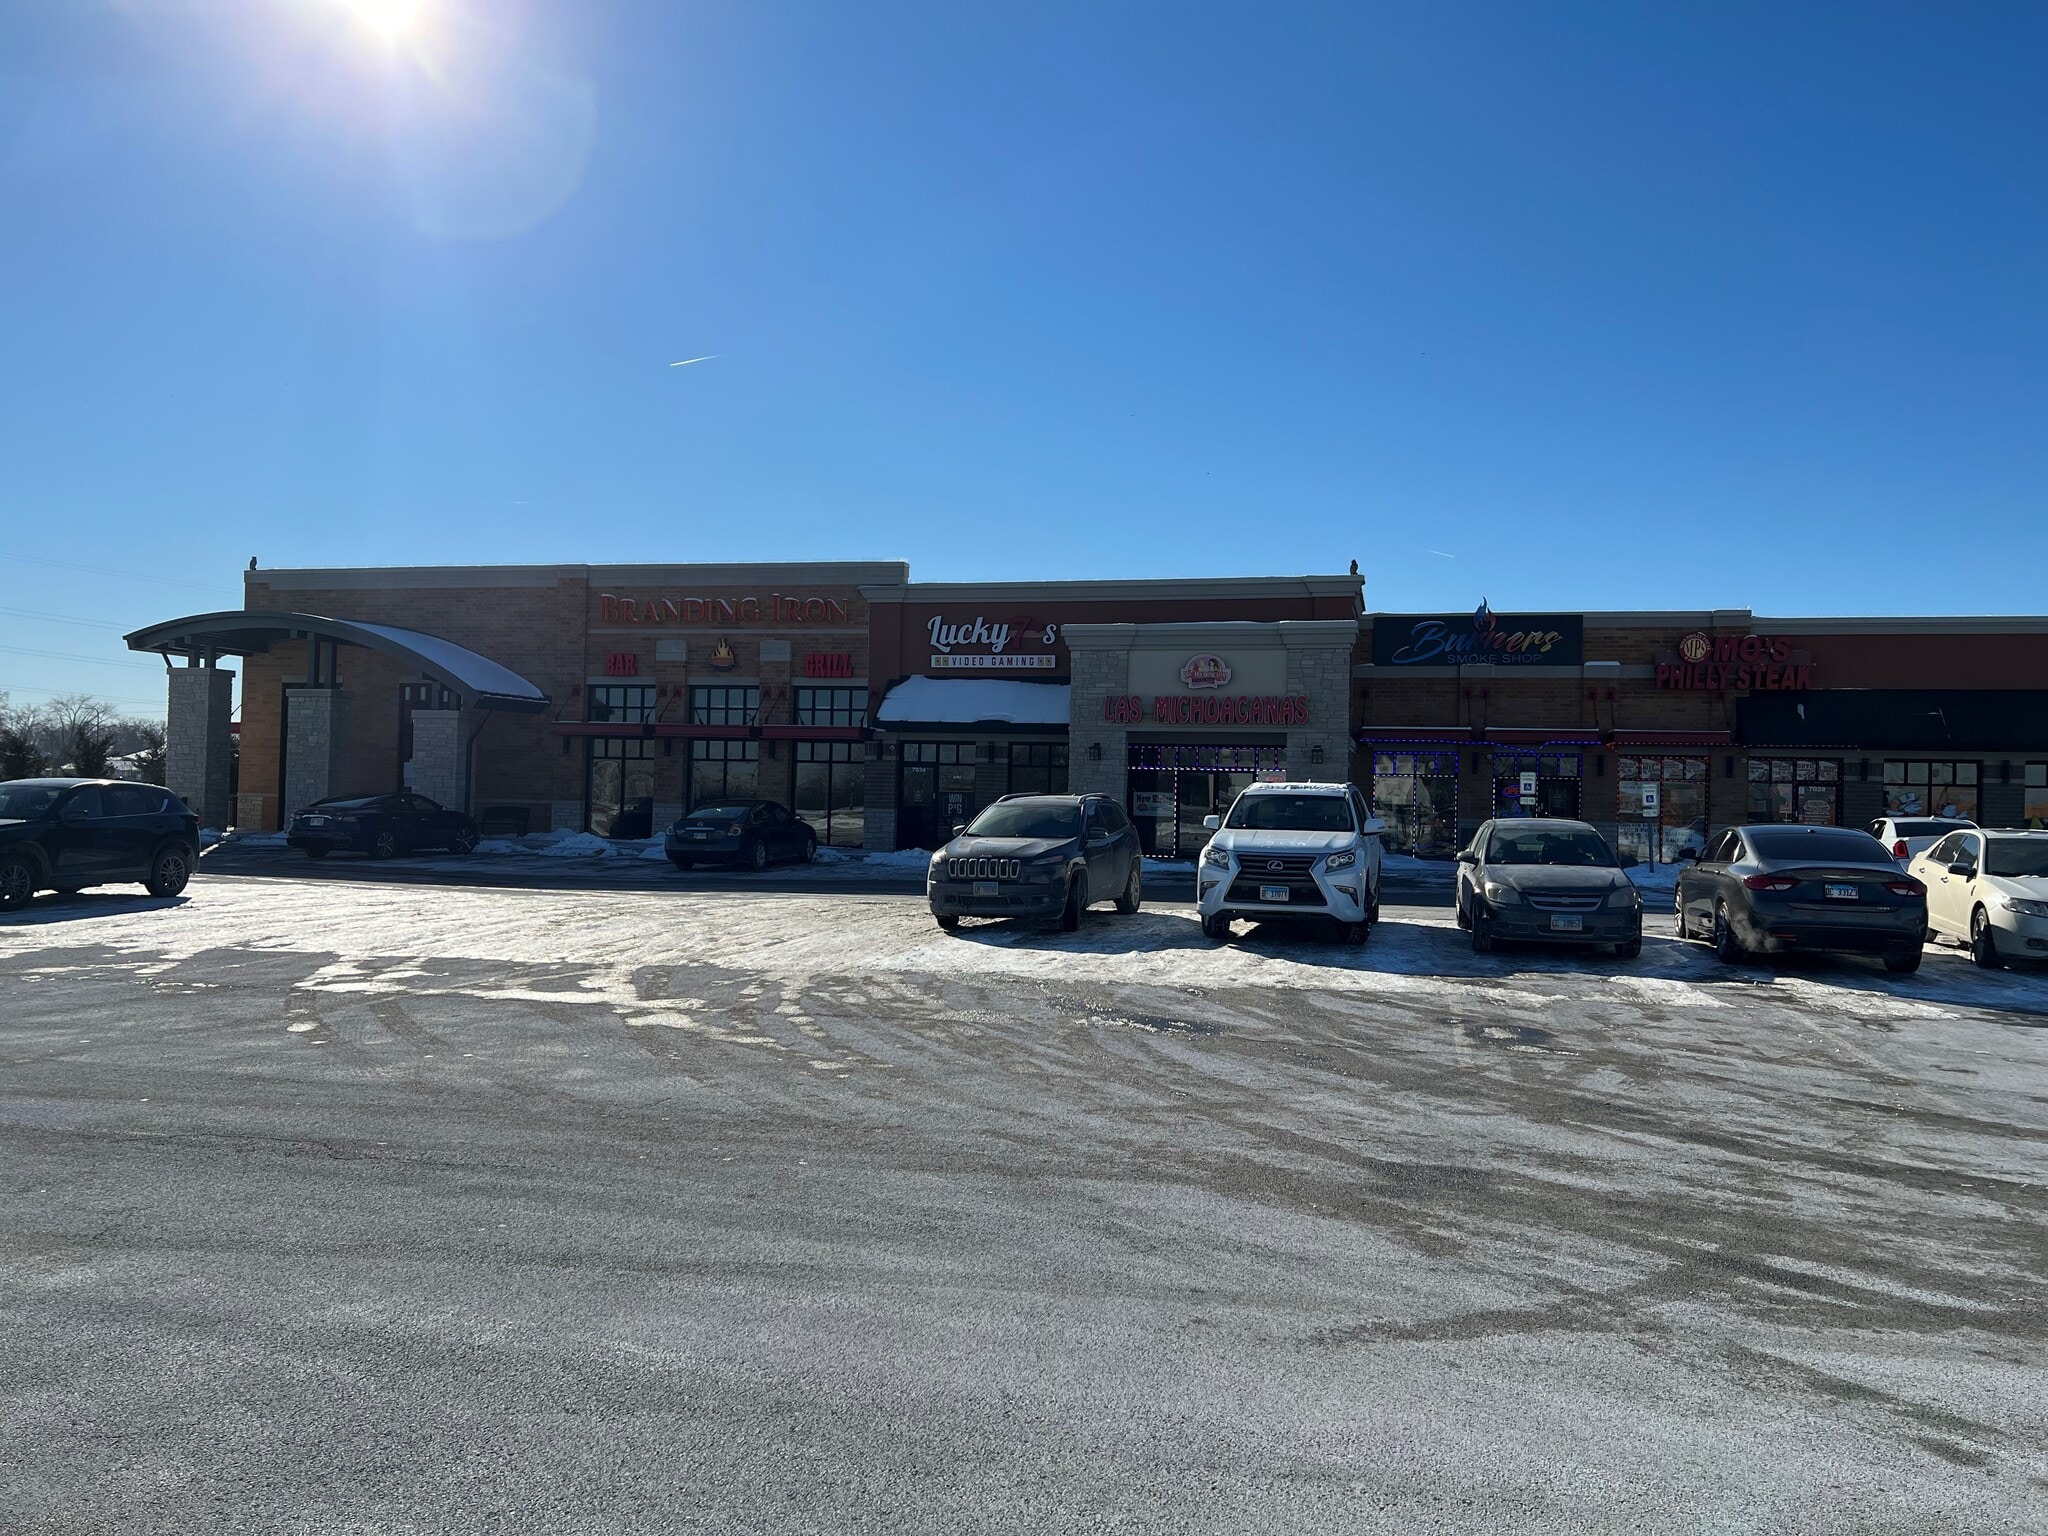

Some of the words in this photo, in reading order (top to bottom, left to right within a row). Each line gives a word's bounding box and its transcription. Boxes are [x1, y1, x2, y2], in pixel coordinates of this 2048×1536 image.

[599, 593, 759, 624] BRANDING
[771, 593, 848, 624] IRON
[927, 615, 1011, 653] Lucky
[604, 653, 637, 677] BAR
[804, 654, 854, 678] GRILL
[952, 657, 984, 666] VIDEO
[991, 657, 1035, 666] GAMING
[1446, 654, 1497, 665] SMOKE
[1502, 654, 1542, 664] SHOP
[1655, 663, 1731, 690] PHILLY
[1735, 663, 1814, 690] STEAK
[1103, 696, 1143, 723] LAS
[1153, 696, 1309, 724] MICHOACANAS
[1504, 787, 1520, 795] OPE
